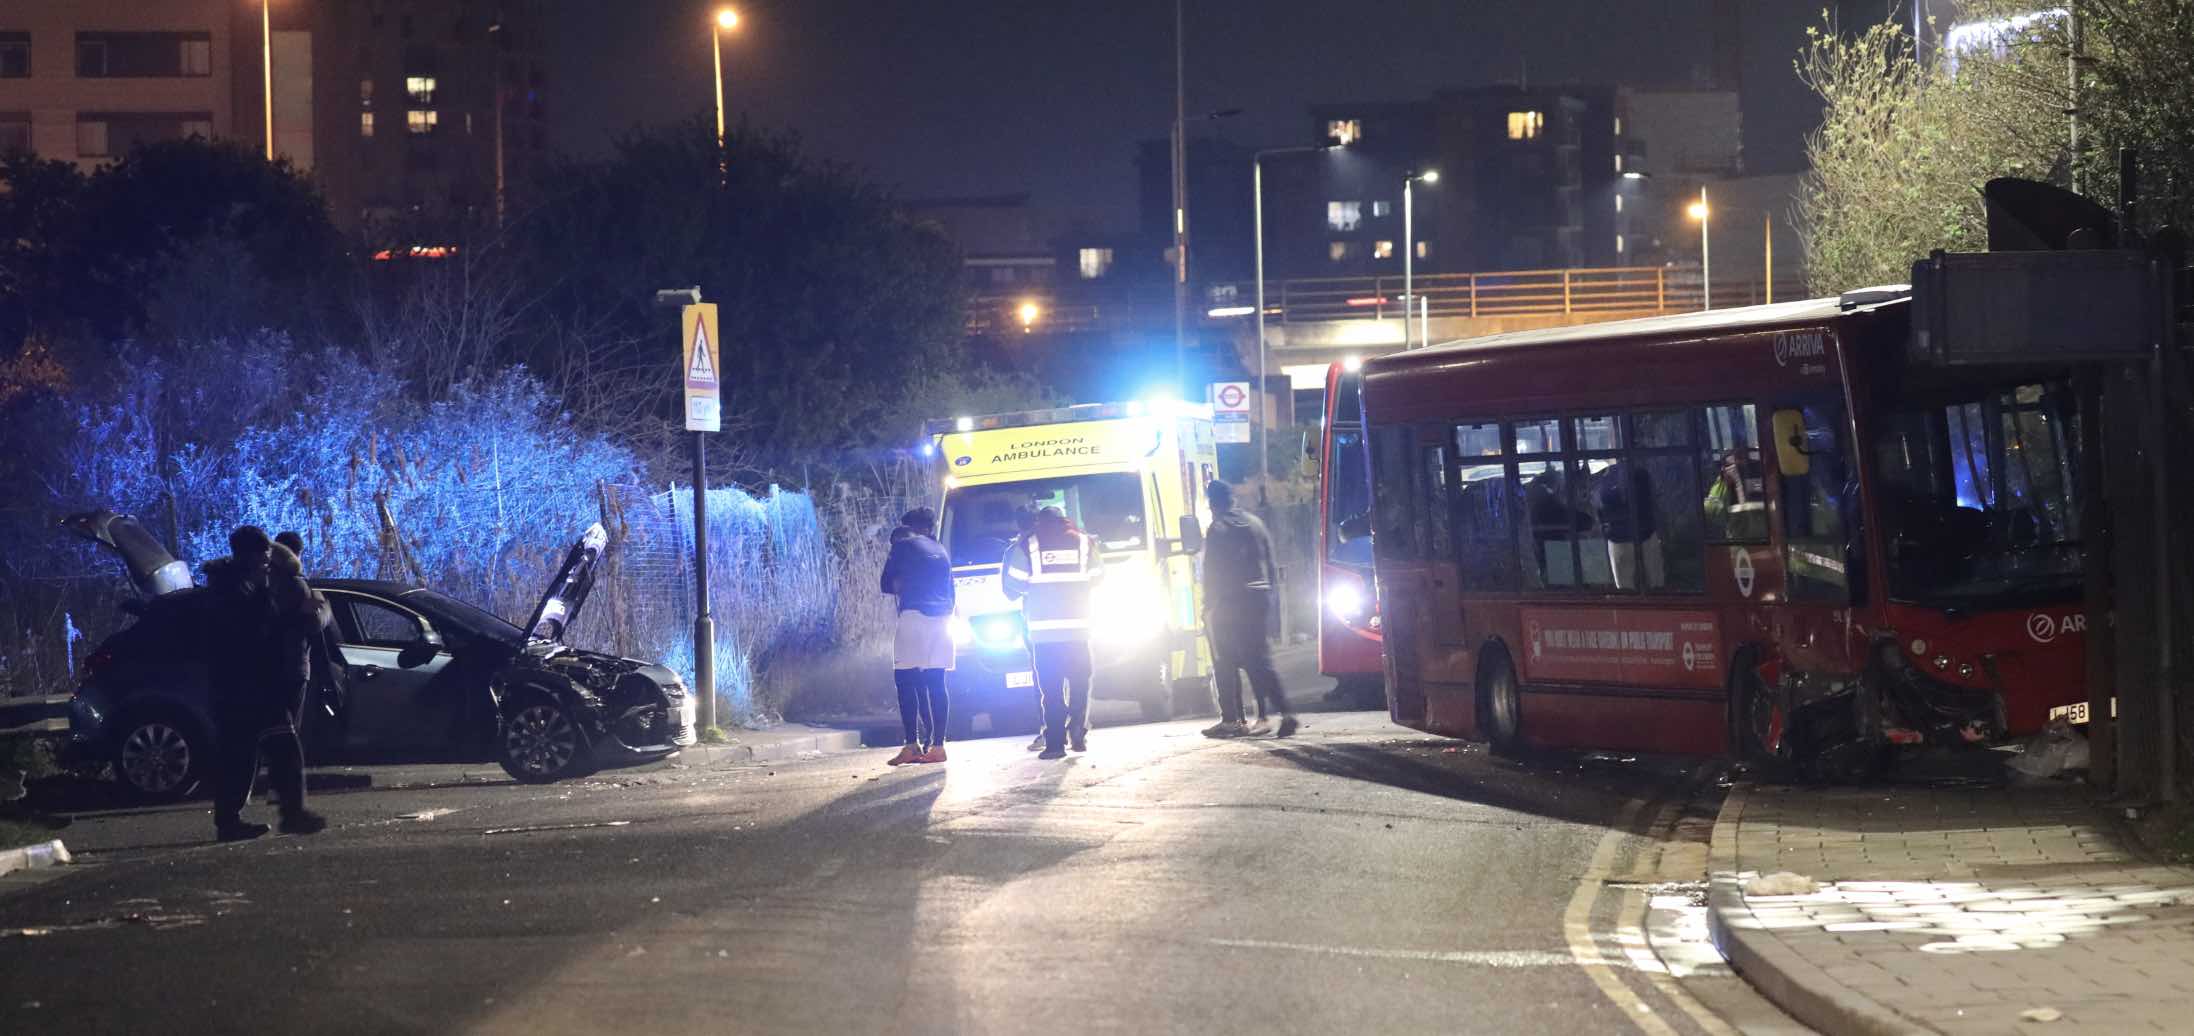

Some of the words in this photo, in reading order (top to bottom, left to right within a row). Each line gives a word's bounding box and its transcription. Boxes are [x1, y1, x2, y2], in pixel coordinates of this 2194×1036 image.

[1787, 334, 1825, 355] ARRIVA
[1010, 437, 1084, 450] LONDON
[992, 446, 1102, 464] AMBULANCE
